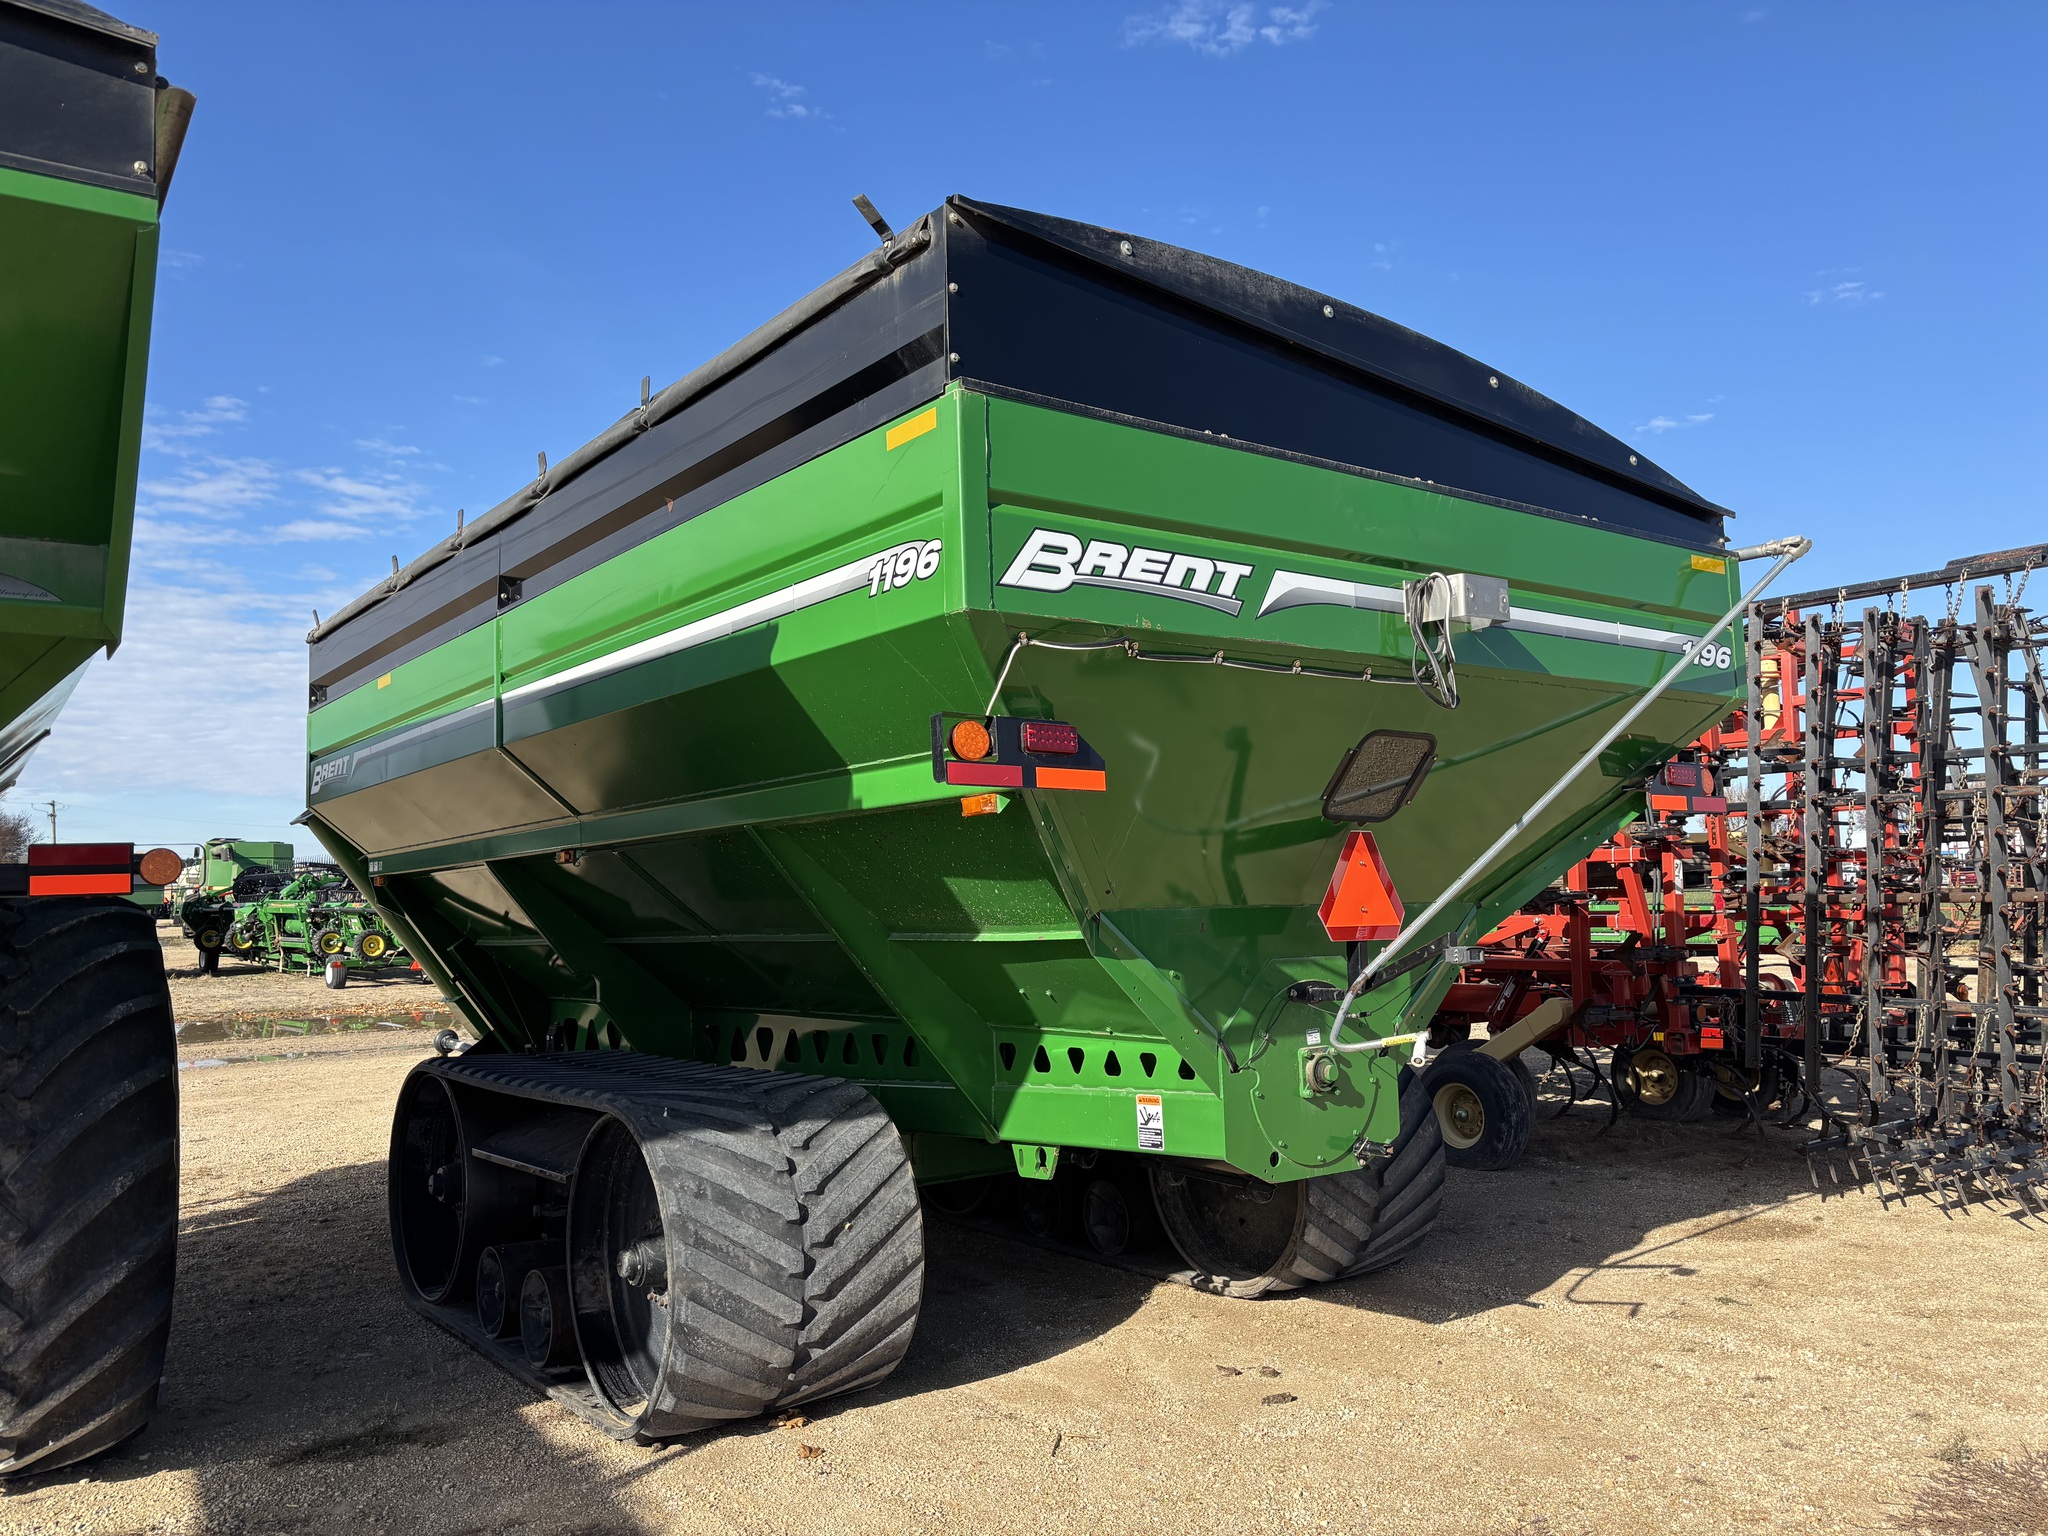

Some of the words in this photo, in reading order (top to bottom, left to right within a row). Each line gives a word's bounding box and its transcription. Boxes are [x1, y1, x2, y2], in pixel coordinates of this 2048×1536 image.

[868, 538, 942, 598] 1196
[997, 527, 1256, 600] BRENT
[311, 755, 350, 795] BRENT
